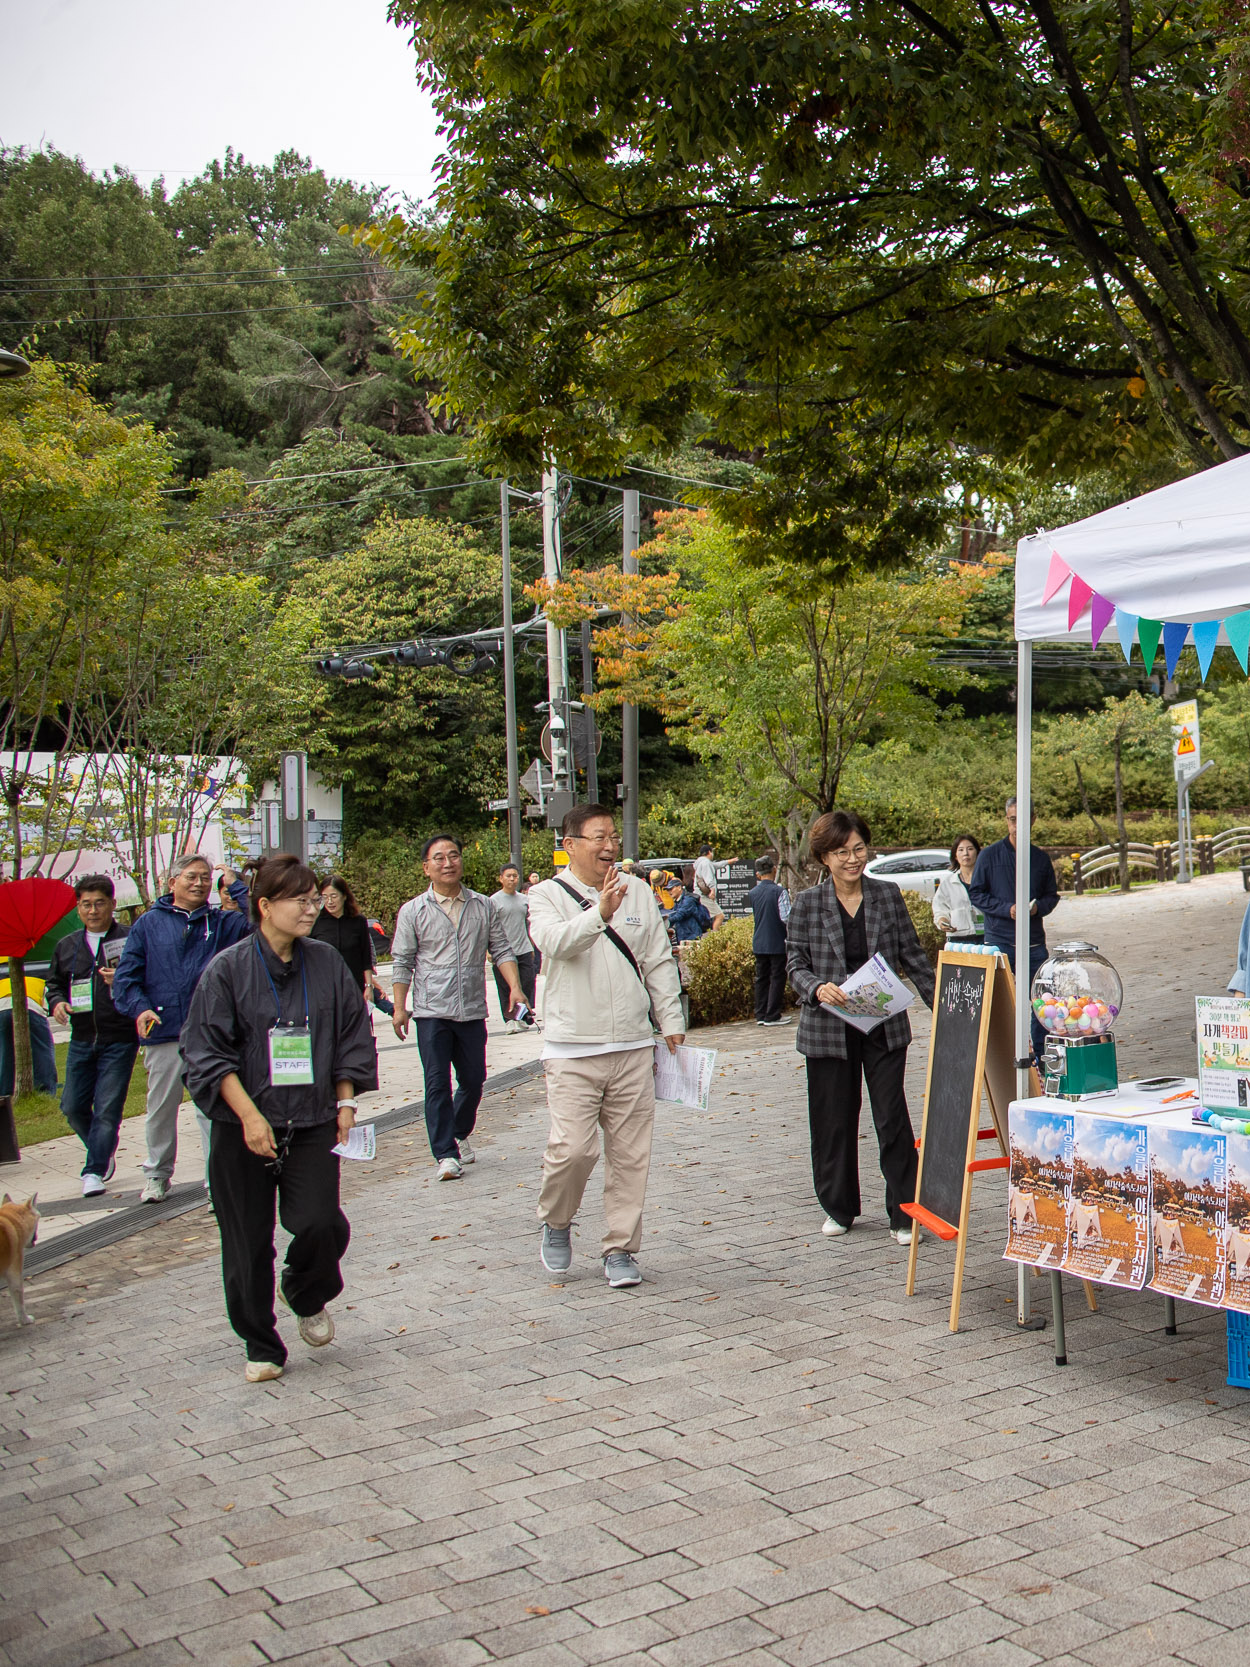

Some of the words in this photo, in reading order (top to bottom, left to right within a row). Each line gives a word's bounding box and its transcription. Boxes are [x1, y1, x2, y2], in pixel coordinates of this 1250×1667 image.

[1203, 1023, 1248, 1040] 자개책갈피
[1212, 1042, 1240, 1057] 만들기
[275, 1061, 309, 1069] STAFF
[1130, 1197, 1148, 1284] 야외도서관
[1210, 1210, 1226, 1301] 야외도서관
